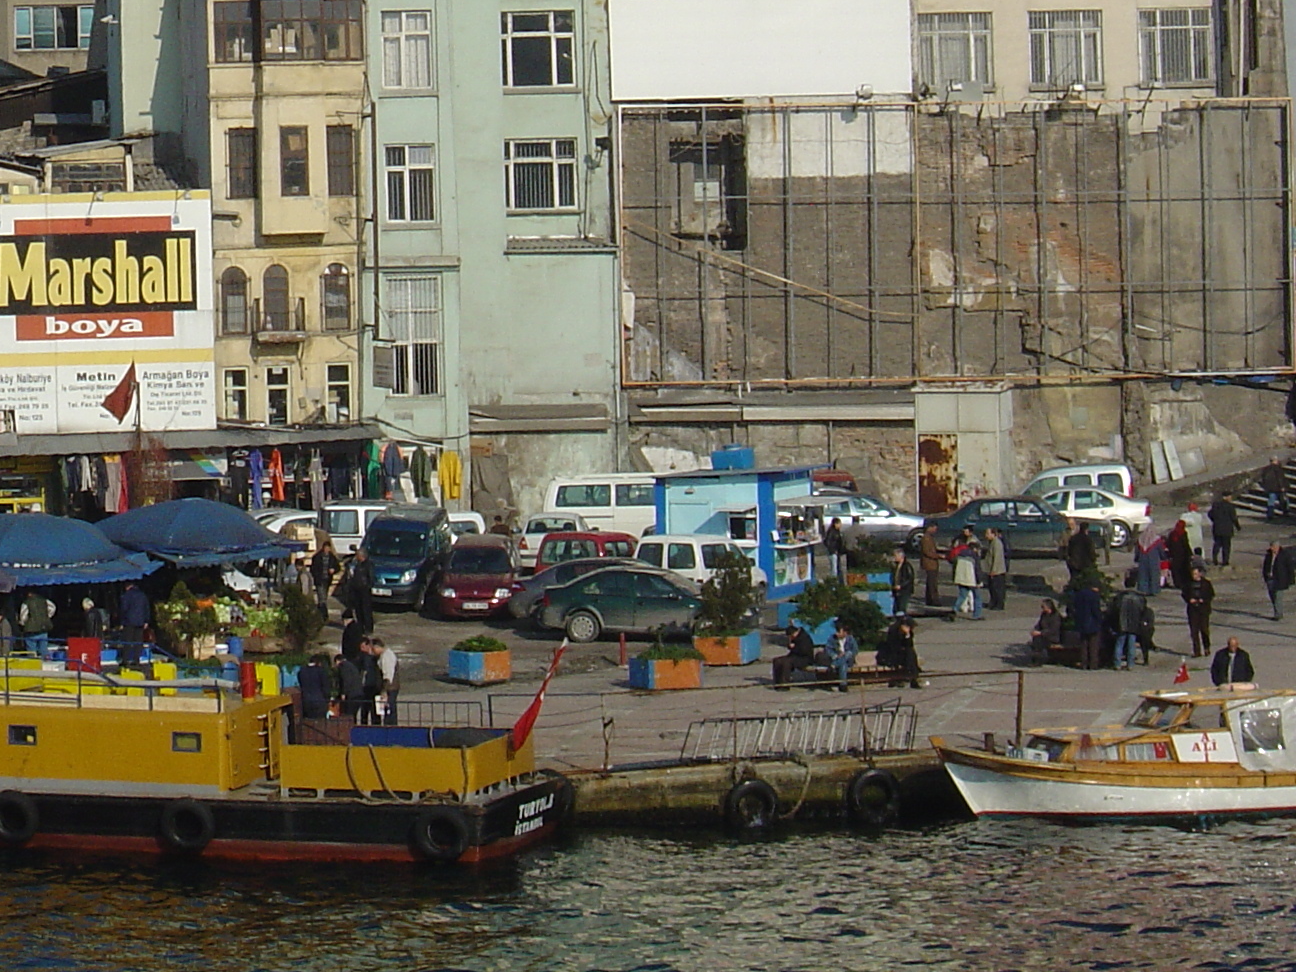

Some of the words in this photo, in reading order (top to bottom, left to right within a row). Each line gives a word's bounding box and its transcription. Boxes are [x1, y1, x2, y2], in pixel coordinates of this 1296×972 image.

[45, 315, 144, 338] boya
[76, 372, 116, 381] Metin
[142, 371, 183, 381] Armağan
[186, 369, 210, 380] Boya
